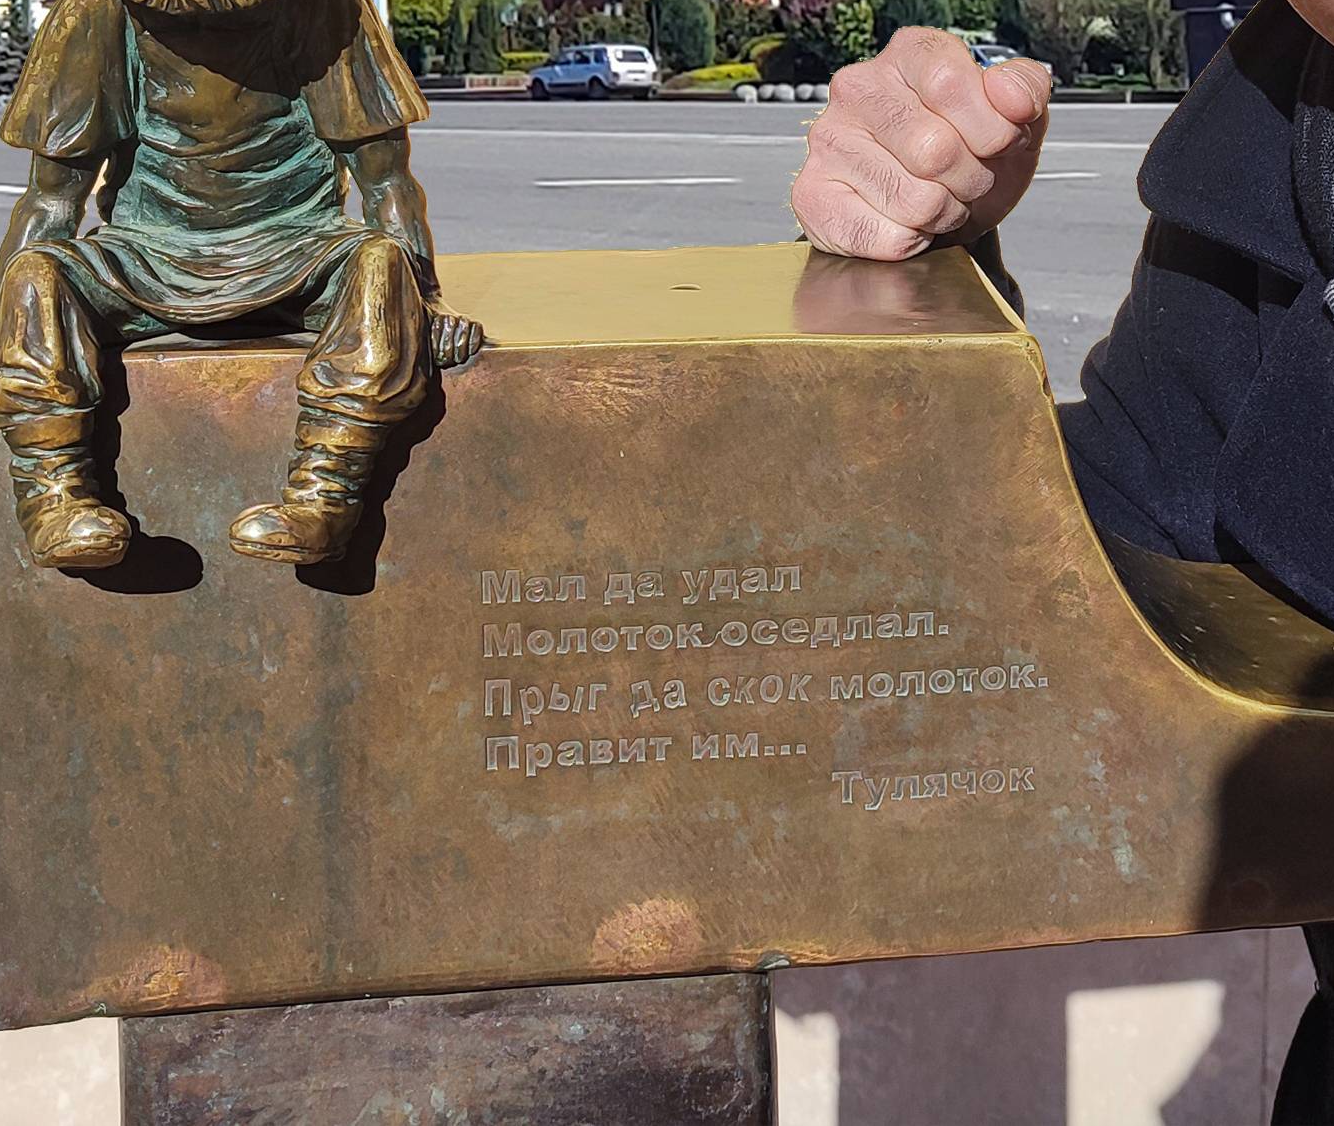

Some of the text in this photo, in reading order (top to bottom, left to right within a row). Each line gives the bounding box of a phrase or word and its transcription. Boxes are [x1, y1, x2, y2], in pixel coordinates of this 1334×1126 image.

[481, 564, 803, 605] Мал да удал
[482, 607, 951, 658] Молоток оседлал.
[483, 663, 1051, 726] Прыг да скок молоток.
[485, 730, 809, 778] Правит им...
[831, 763, 1036, 811] Тулячок
